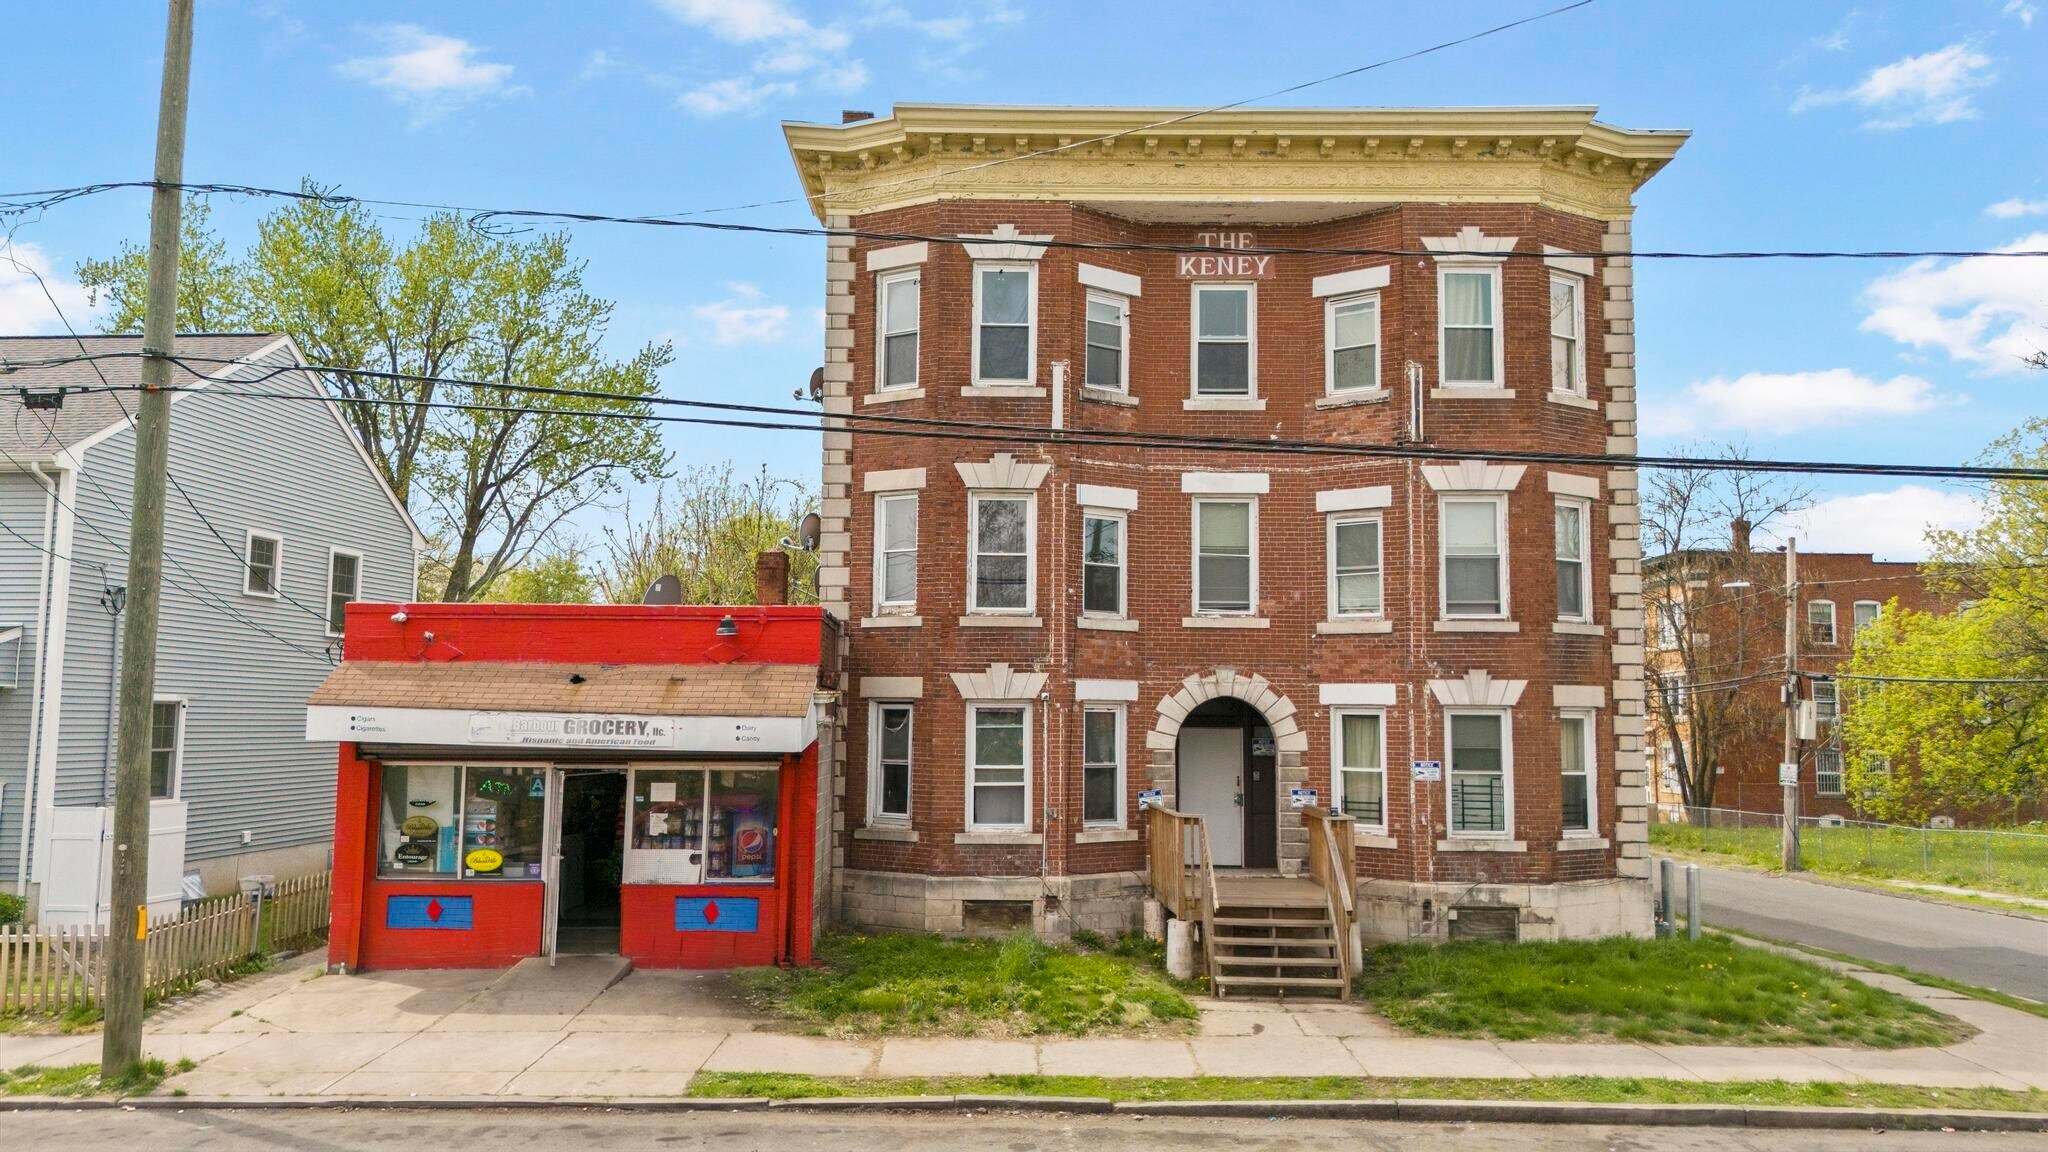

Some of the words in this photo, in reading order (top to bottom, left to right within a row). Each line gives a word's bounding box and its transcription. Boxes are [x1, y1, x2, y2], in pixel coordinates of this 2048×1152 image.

[1198, 232, 1254, 249] THE
[1180, 256, 1271, 275] KENEY
[563, 719, 650, 737] GROCERY,
[521, 736, 564, 745] Hispanic
[566, 737, 584, 745] and
[585, 738, 632, 746] American
[633, 738, 656, 746] Food
[398, 853, 428, 861] Entourage
[741, 854, 762, 862] pepsi
